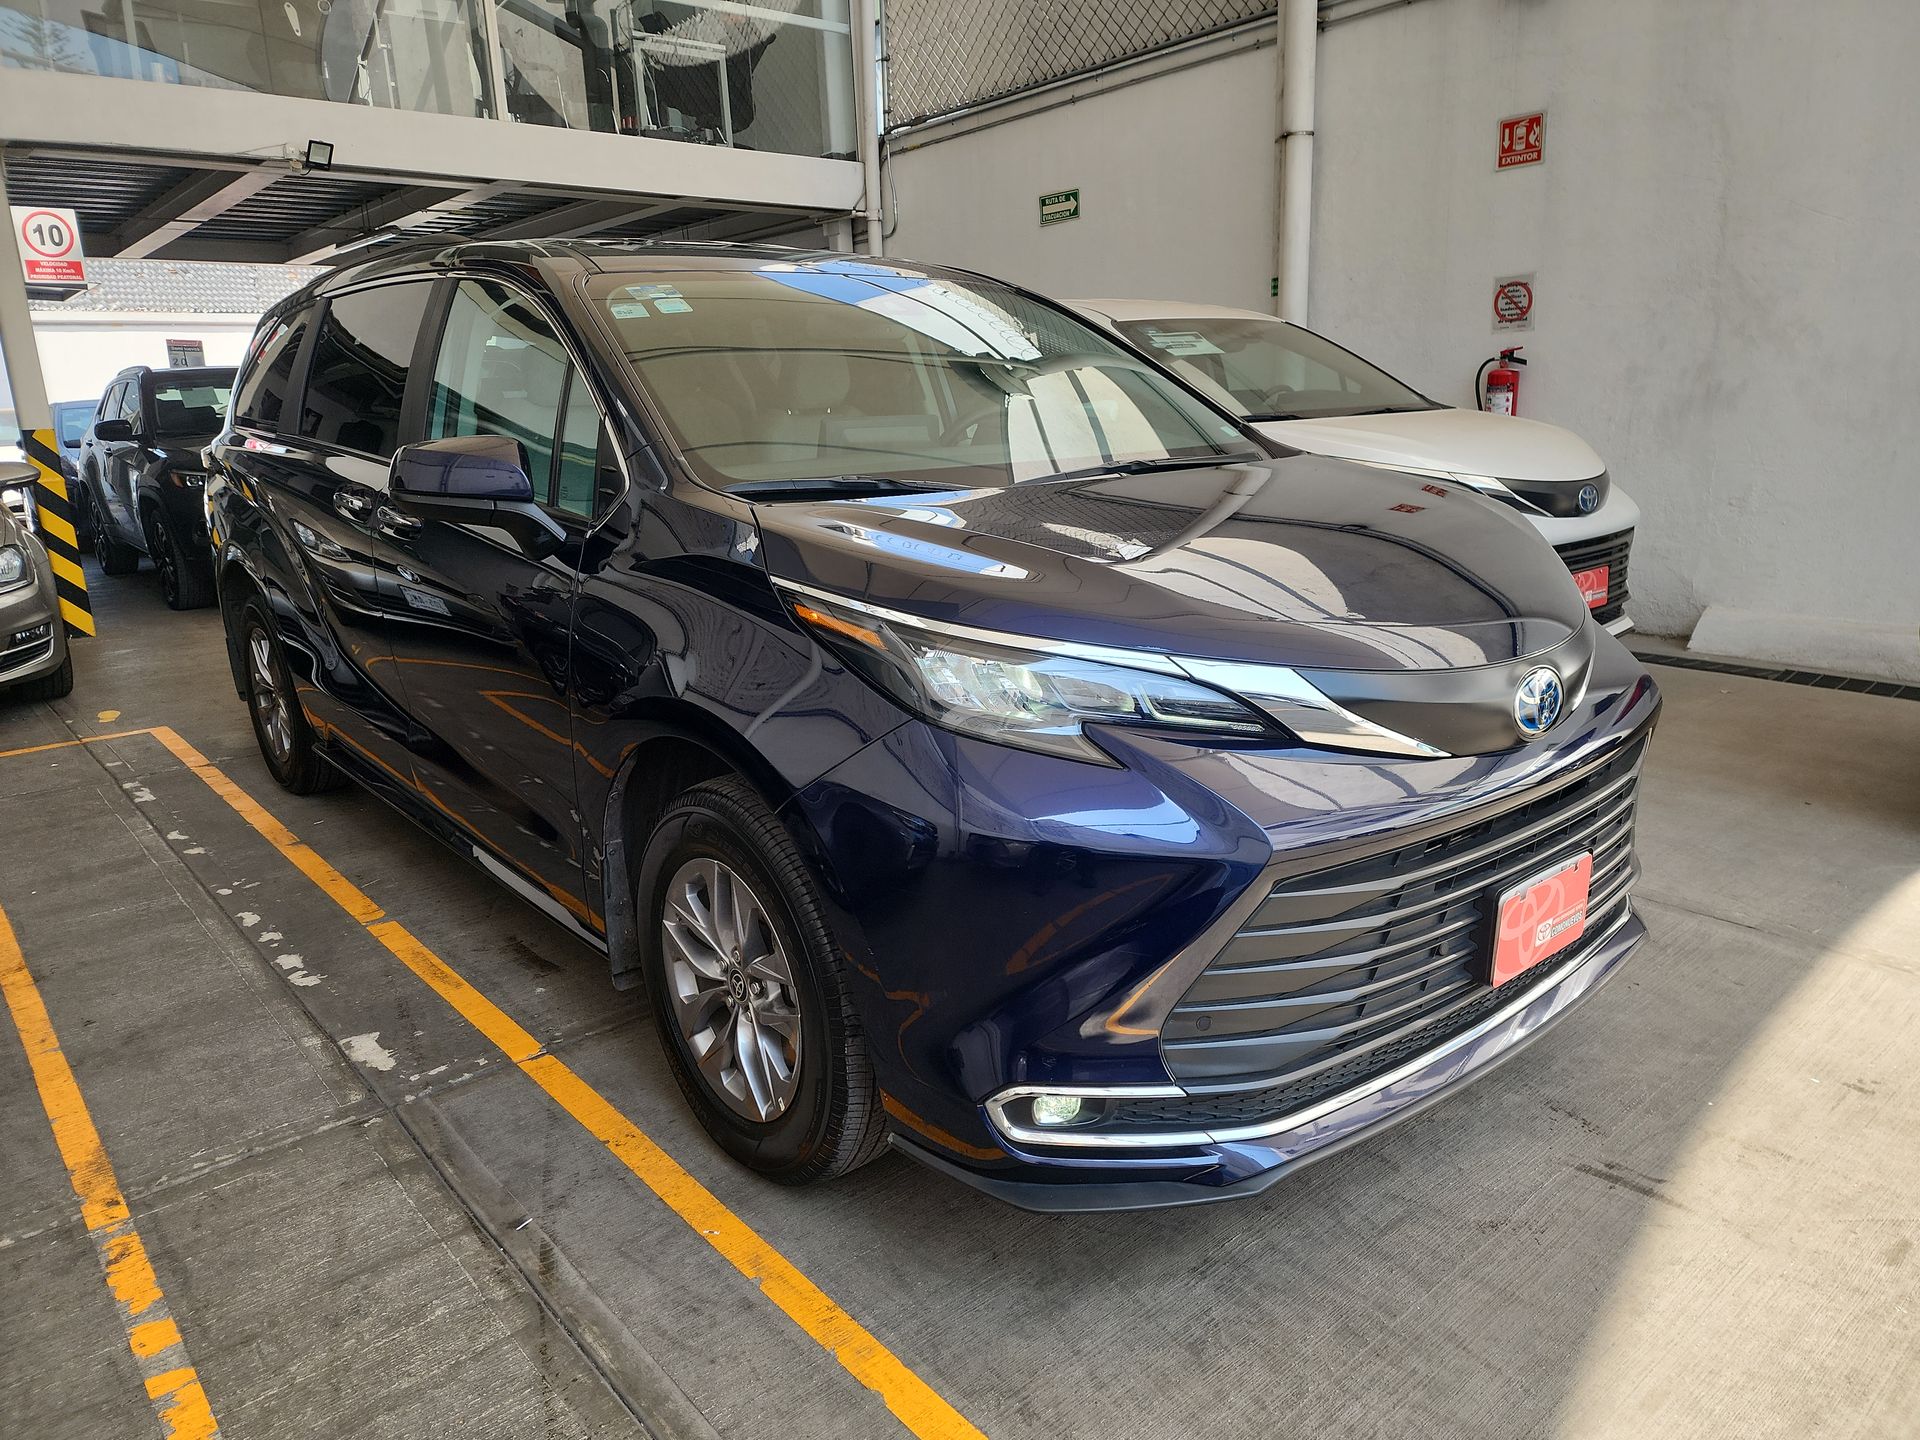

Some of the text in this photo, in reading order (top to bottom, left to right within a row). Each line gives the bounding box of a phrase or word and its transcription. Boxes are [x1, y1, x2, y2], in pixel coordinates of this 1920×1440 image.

[1501, 152, 1538, 165] EXTINTOR
[1045, 197, 1058, 205] RUTA
[32, 223, 64, 247] 10
